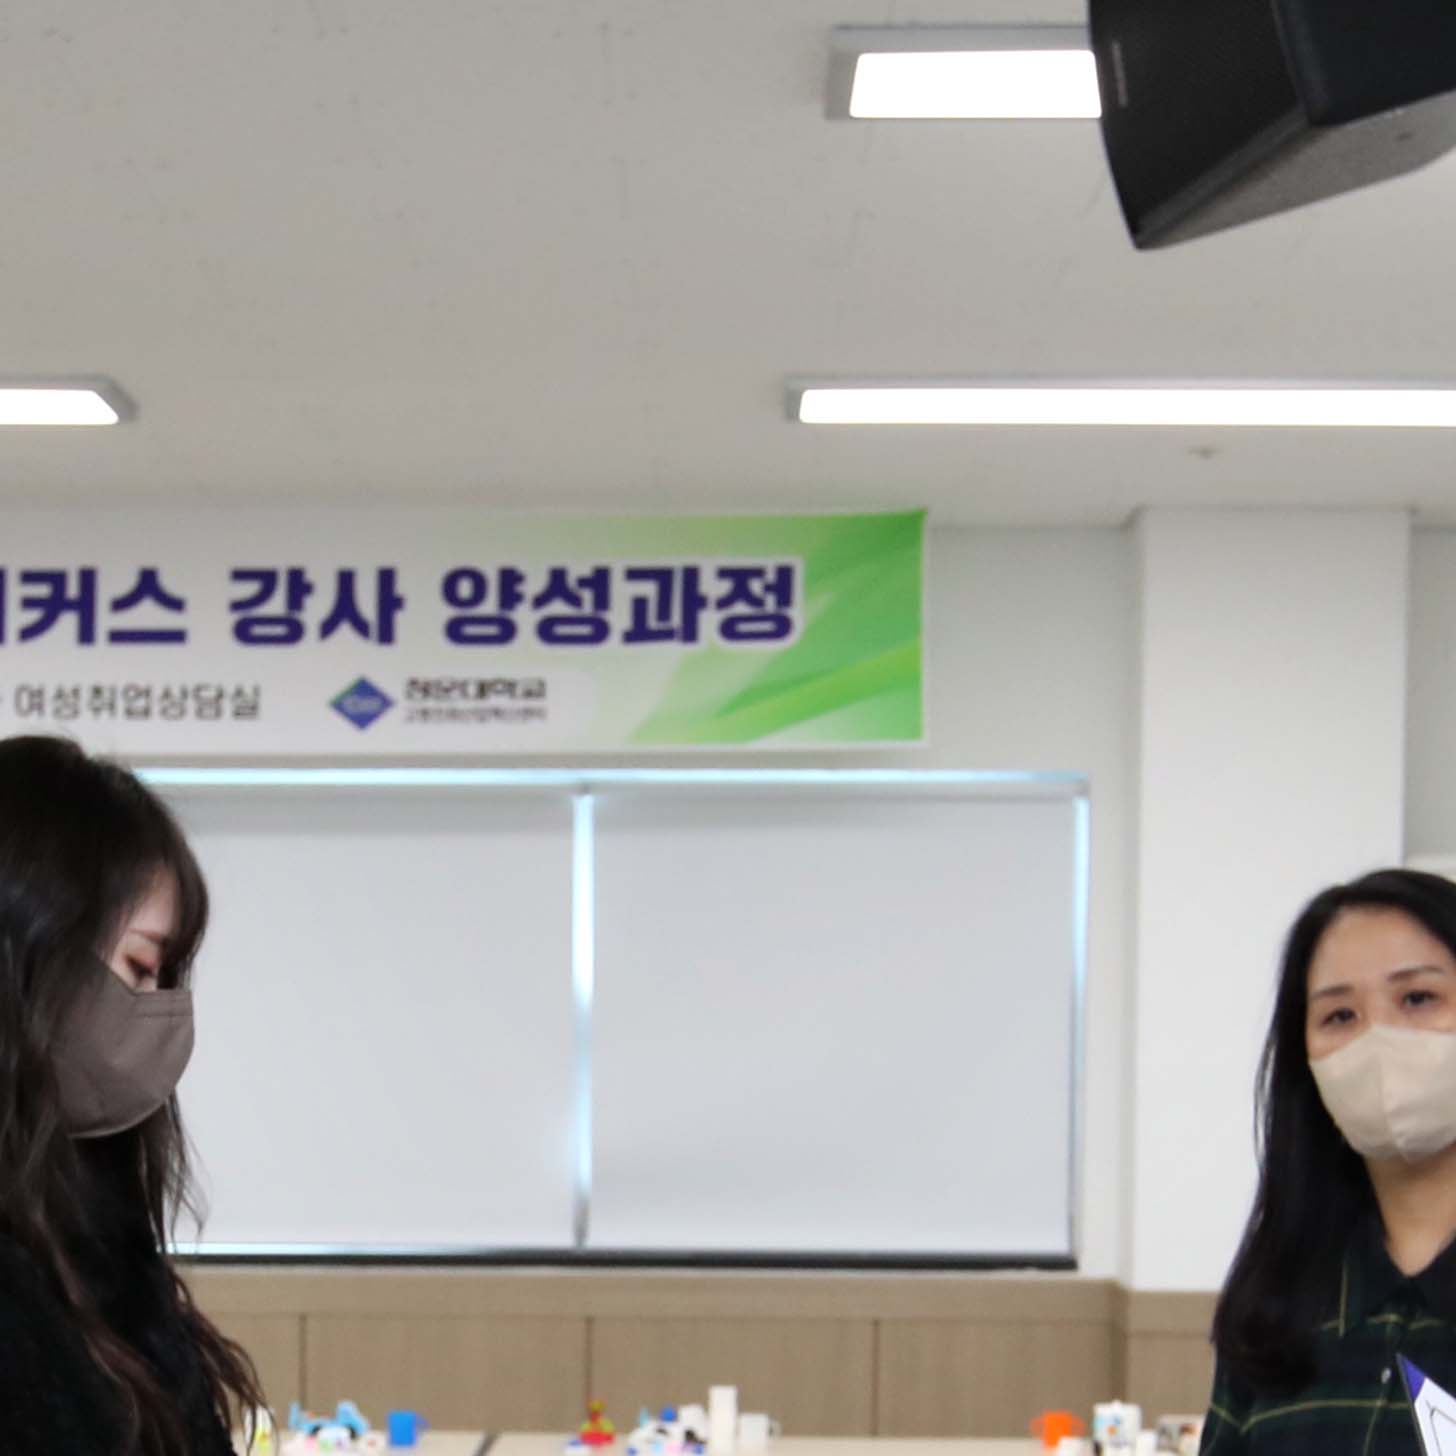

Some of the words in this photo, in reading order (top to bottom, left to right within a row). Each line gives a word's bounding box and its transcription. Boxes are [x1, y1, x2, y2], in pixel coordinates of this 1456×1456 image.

[229, 567, 404, 646] 강사
[442, 566, 795, 646] 양성과정
[13, 683, 261, 720] 여성취업상담실
